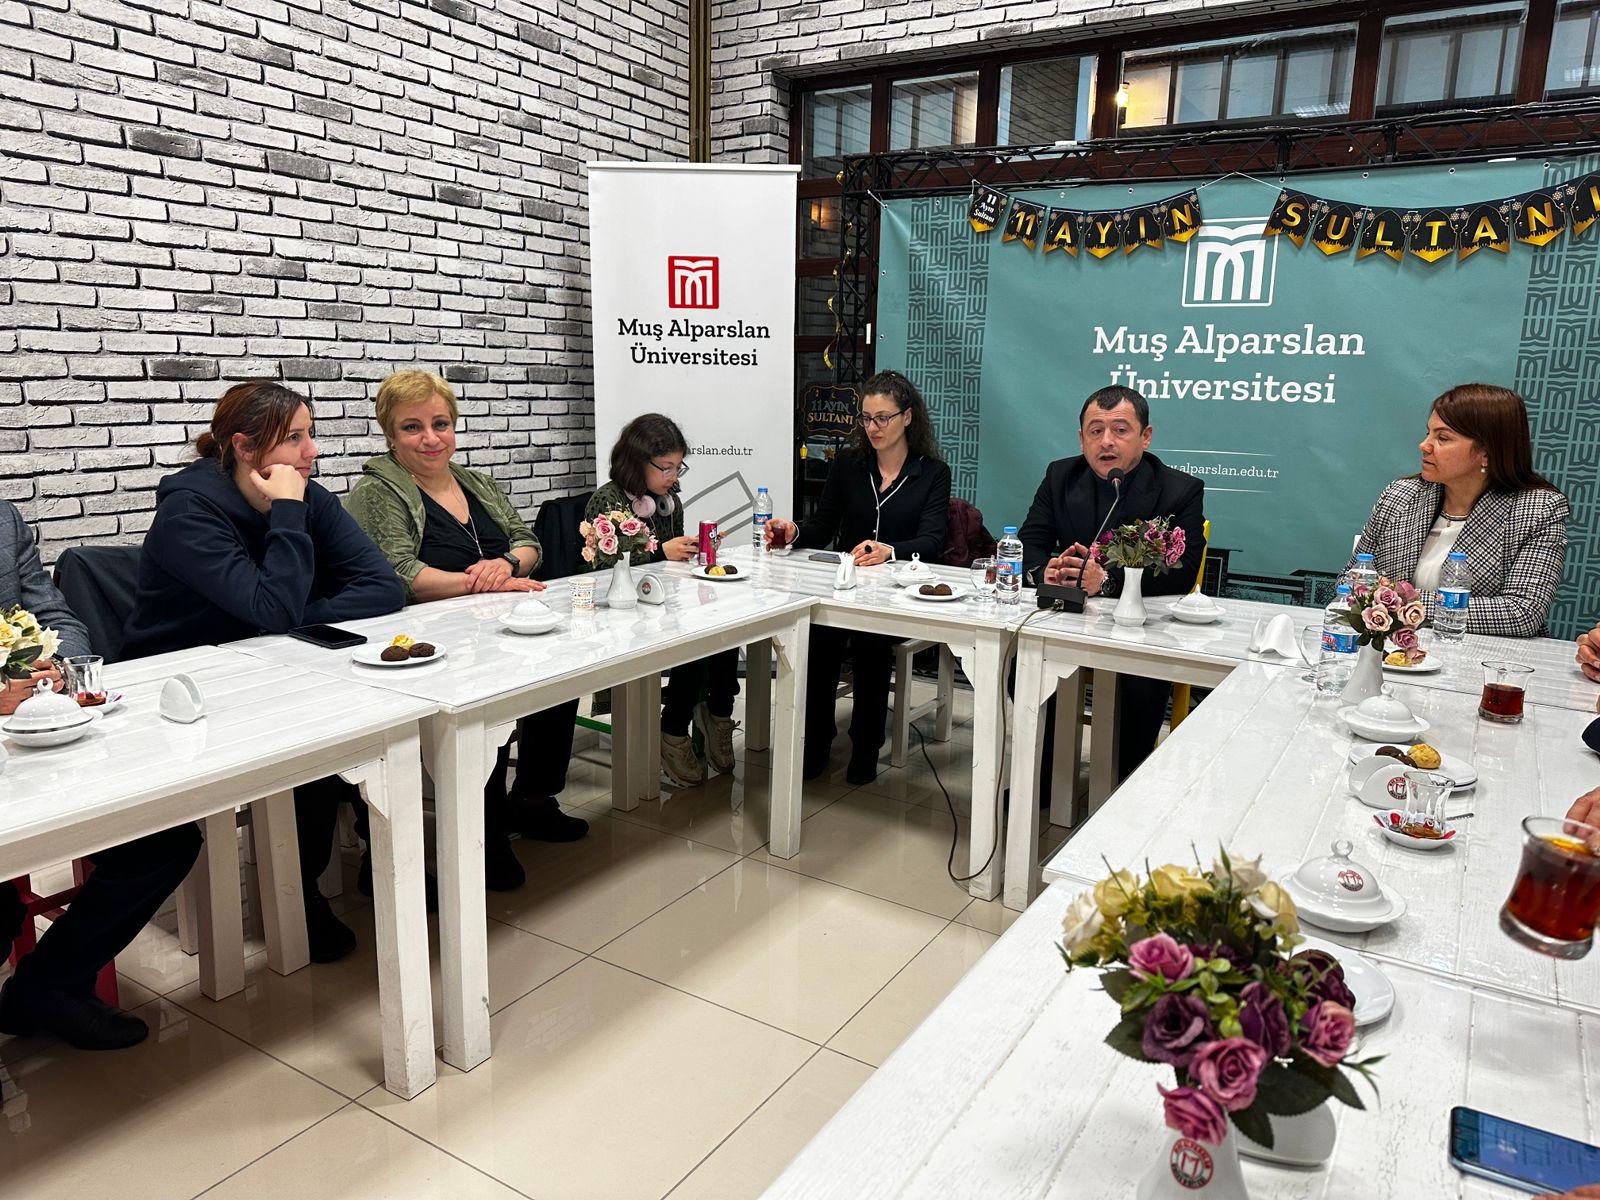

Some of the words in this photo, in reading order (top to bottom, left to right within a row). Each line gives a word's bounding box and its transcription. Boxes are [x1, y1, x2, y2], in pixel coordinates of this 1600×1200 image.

[987, 194, 997, 205] 11
[1014, 211, 1036, 236] 11
[617, 318, 663, 341] Muş
[667, 319, 771, 342] Alparslan
[630, 342, 759, 366] Üniversitesi
[1092, 326, 1168, 361] Muş
[1174, 323, 1366, 363] Alparslan
[1110, 364, 1336, 404] Üniversitesi
[806, 412, 854, 425] SULTANI
